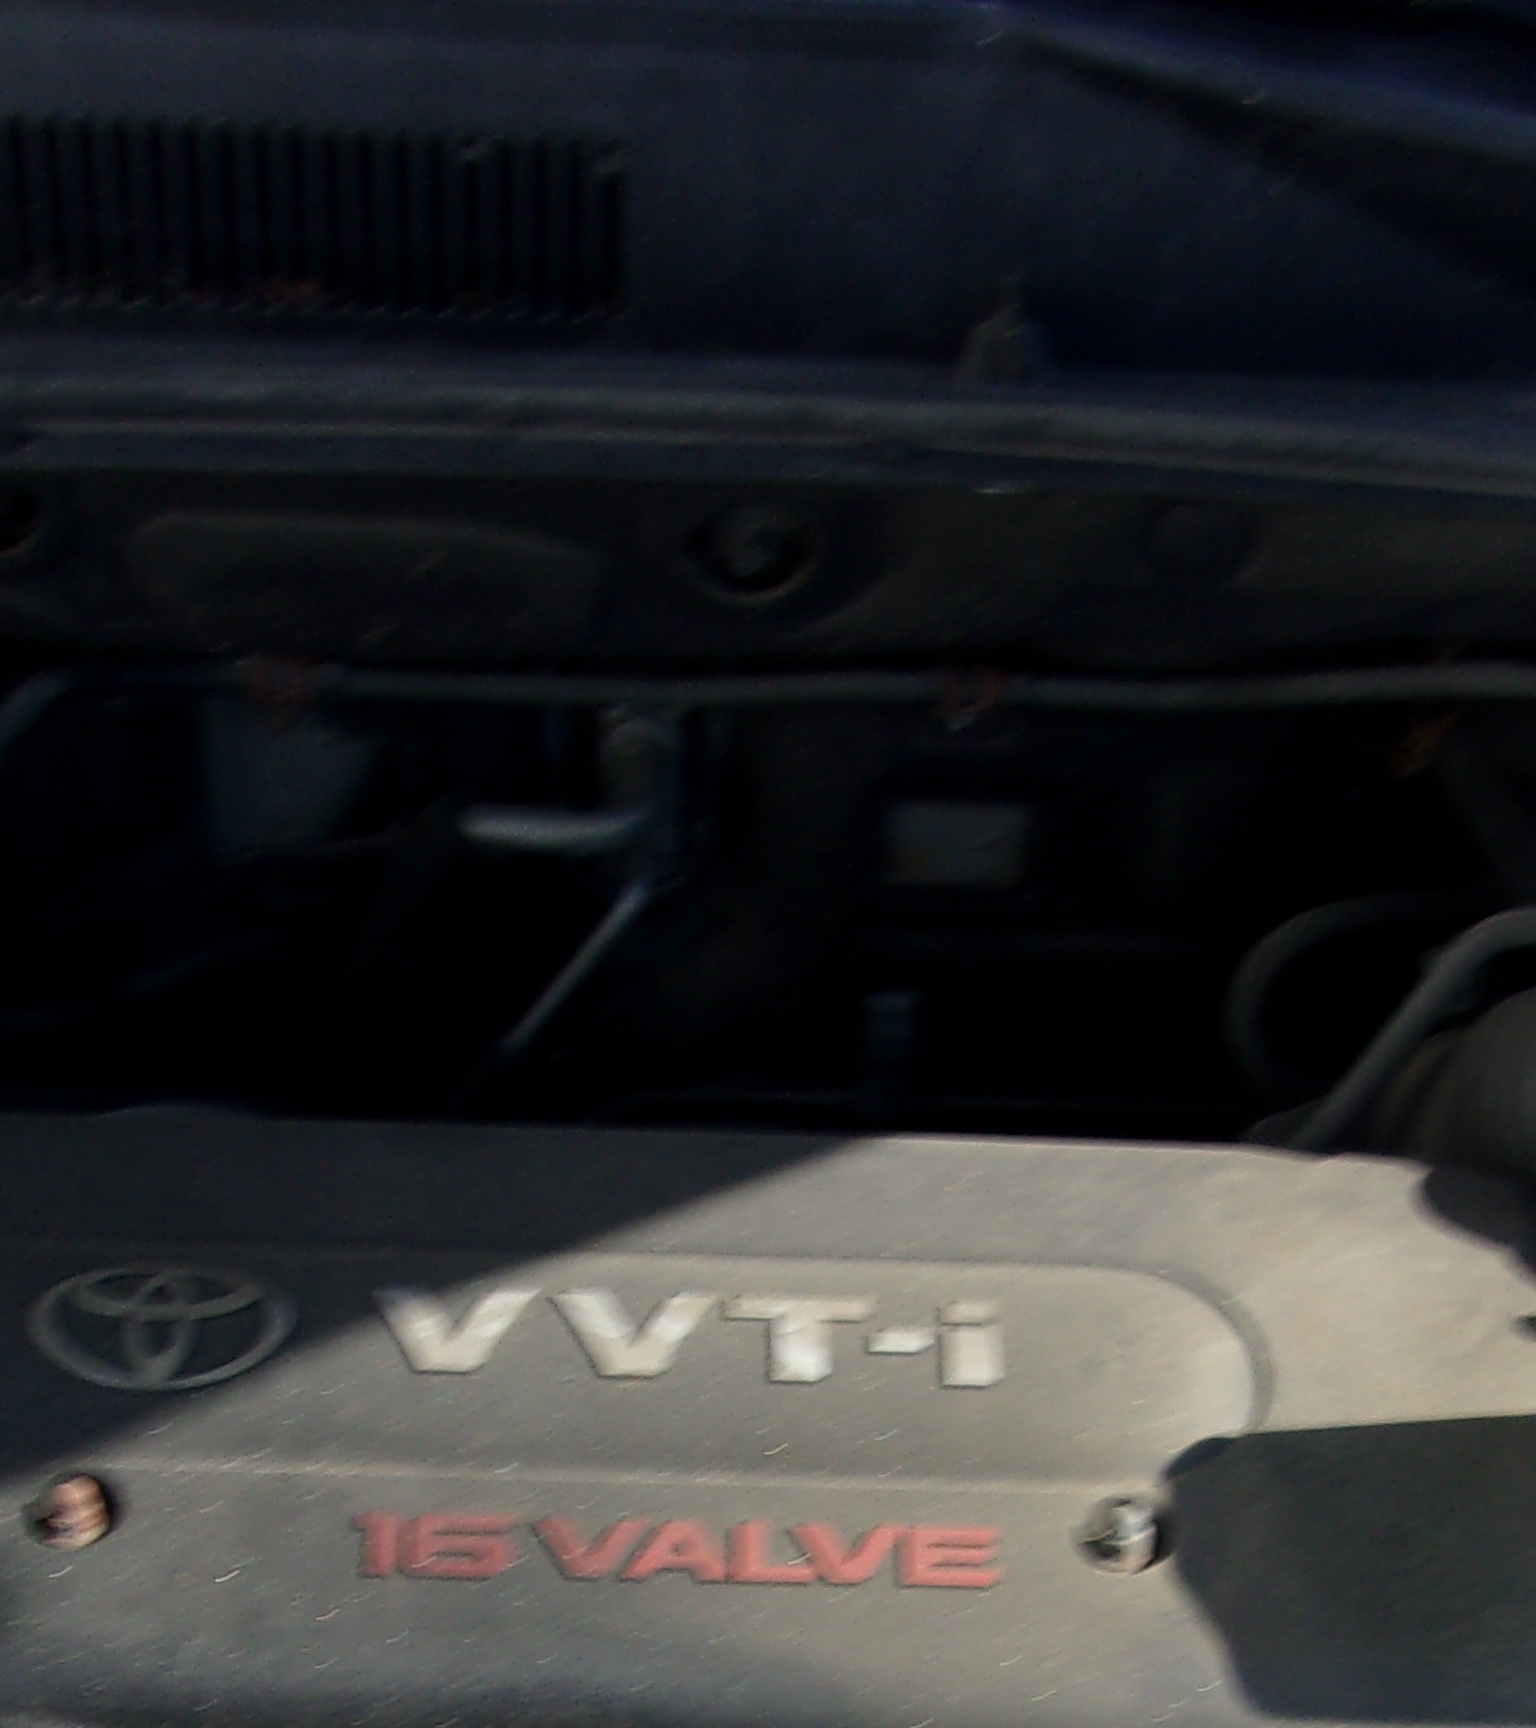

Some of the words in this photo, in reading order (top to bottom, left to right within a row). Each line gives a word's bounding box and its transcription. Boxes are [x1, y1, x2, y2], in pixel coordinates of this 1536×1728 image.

[372, 1287, 1005, 1388] VVT-i
[352, 1513, 520, 1579] 16
[534, 1516, 1004, 1588] VALVE
